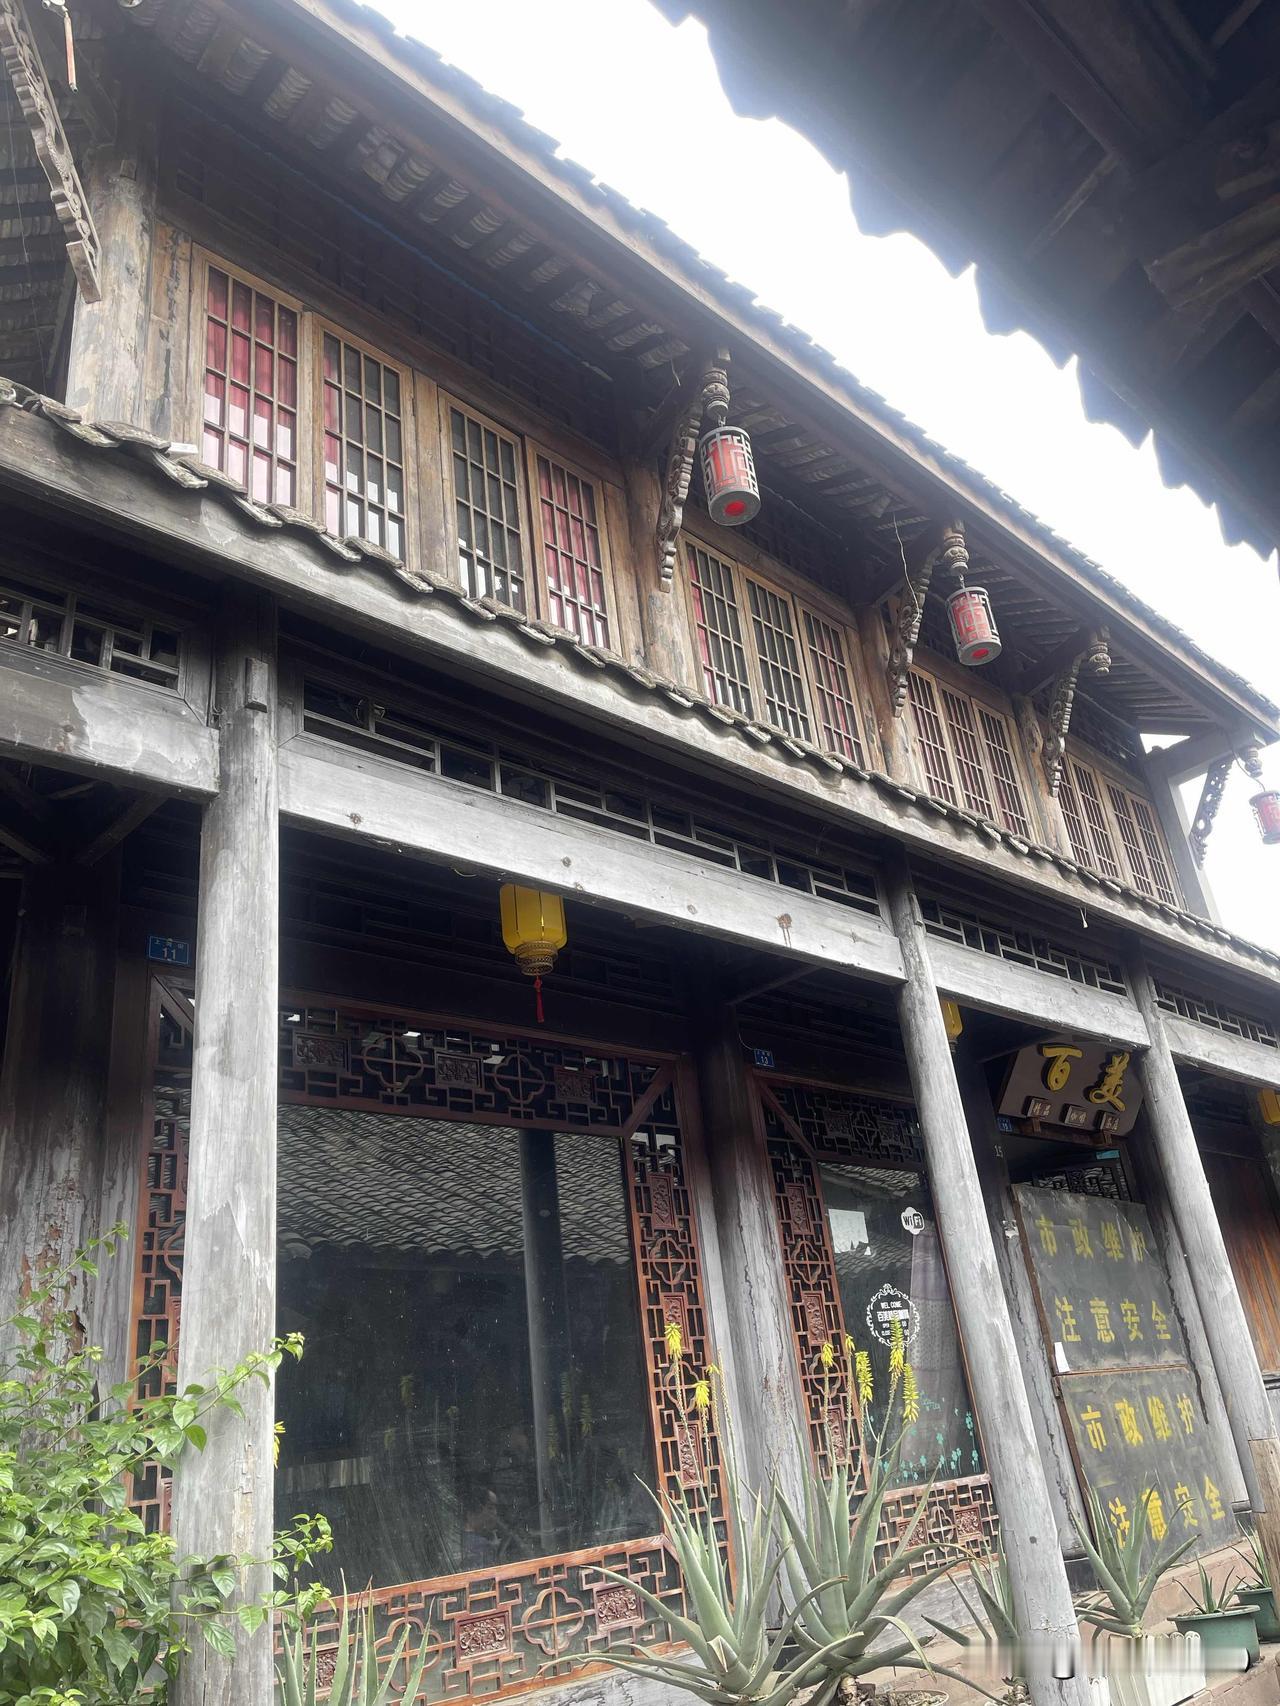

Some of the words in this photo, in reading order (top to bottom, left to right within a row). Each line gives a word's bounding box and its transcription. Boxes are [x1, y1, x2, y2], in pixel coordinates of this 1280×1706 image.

[162, 947, 176, 960] 11
[1055, 1296, 1171, 1343] 注意安全
[1081, 1392, 1195, 1453] 市政维护
[1108, 1474, 1226, 1550] 注意安全
